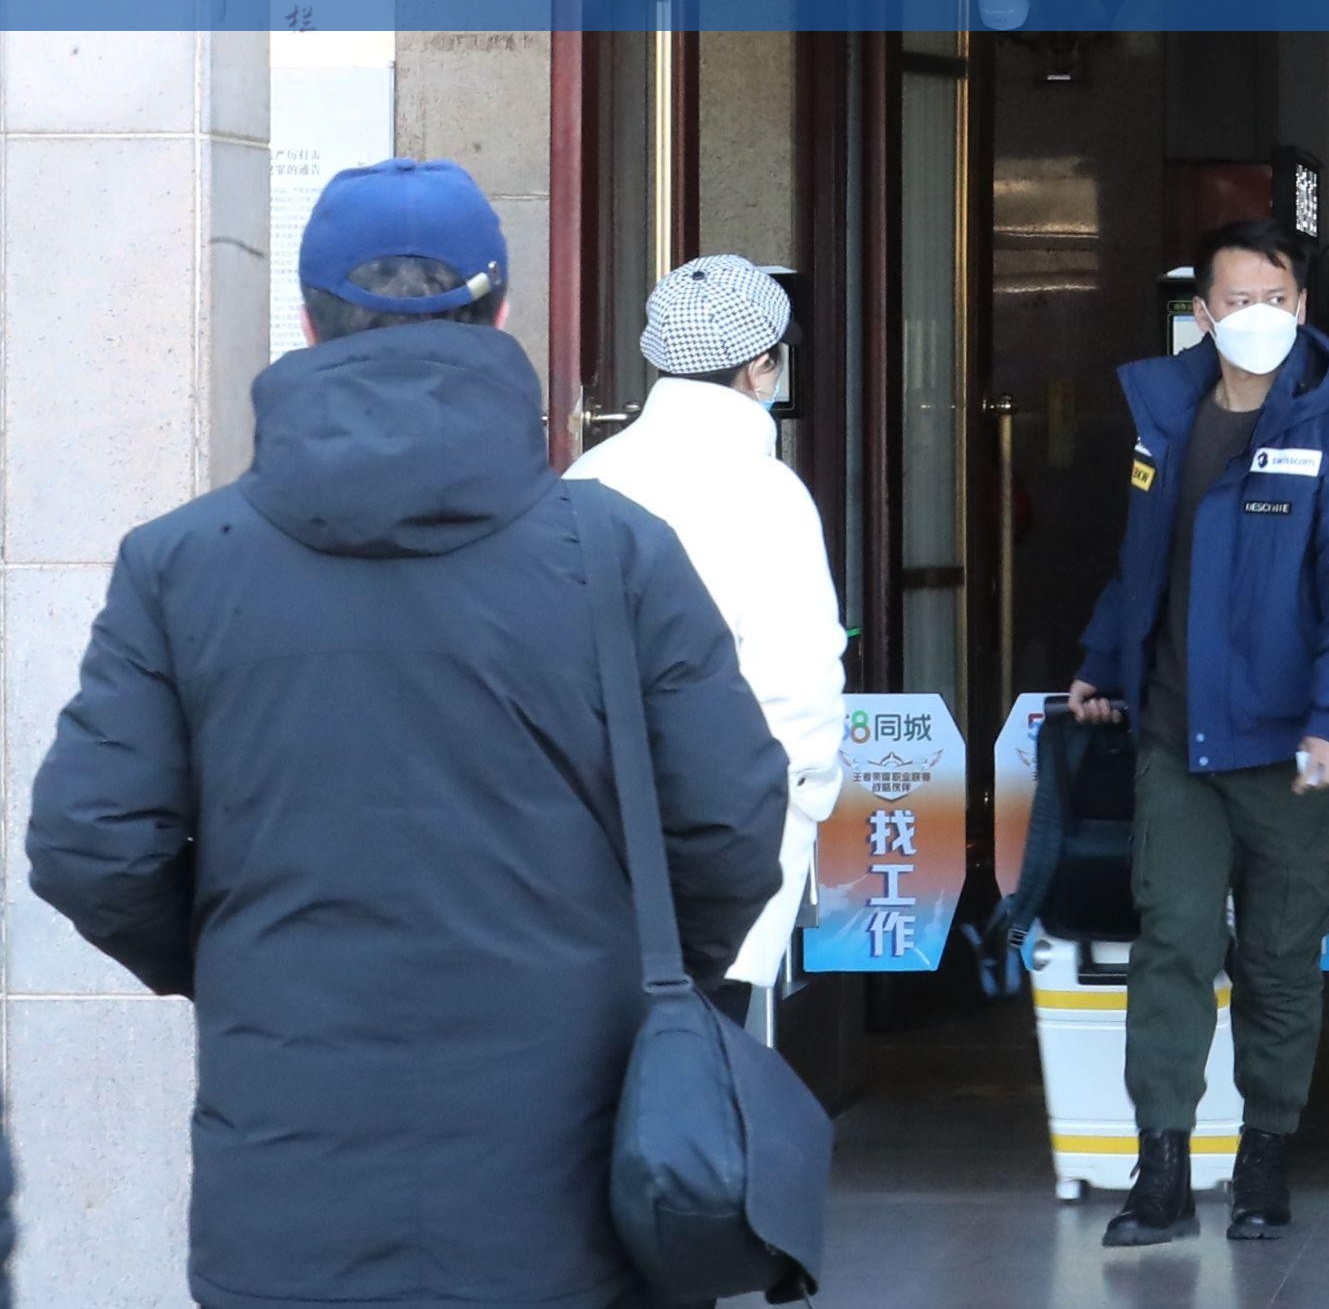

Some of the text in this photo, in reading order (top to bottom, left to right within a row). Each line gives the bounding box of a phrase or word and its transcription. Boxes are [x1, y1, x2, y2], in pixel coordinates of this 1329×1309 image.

[269, 148, 320, 160] 严厉打击
[269, 164, 320, 176] 罪的通告
[1272, 455, 1315, 467] swisscom
[866, 809, 917, 957] 找工作
